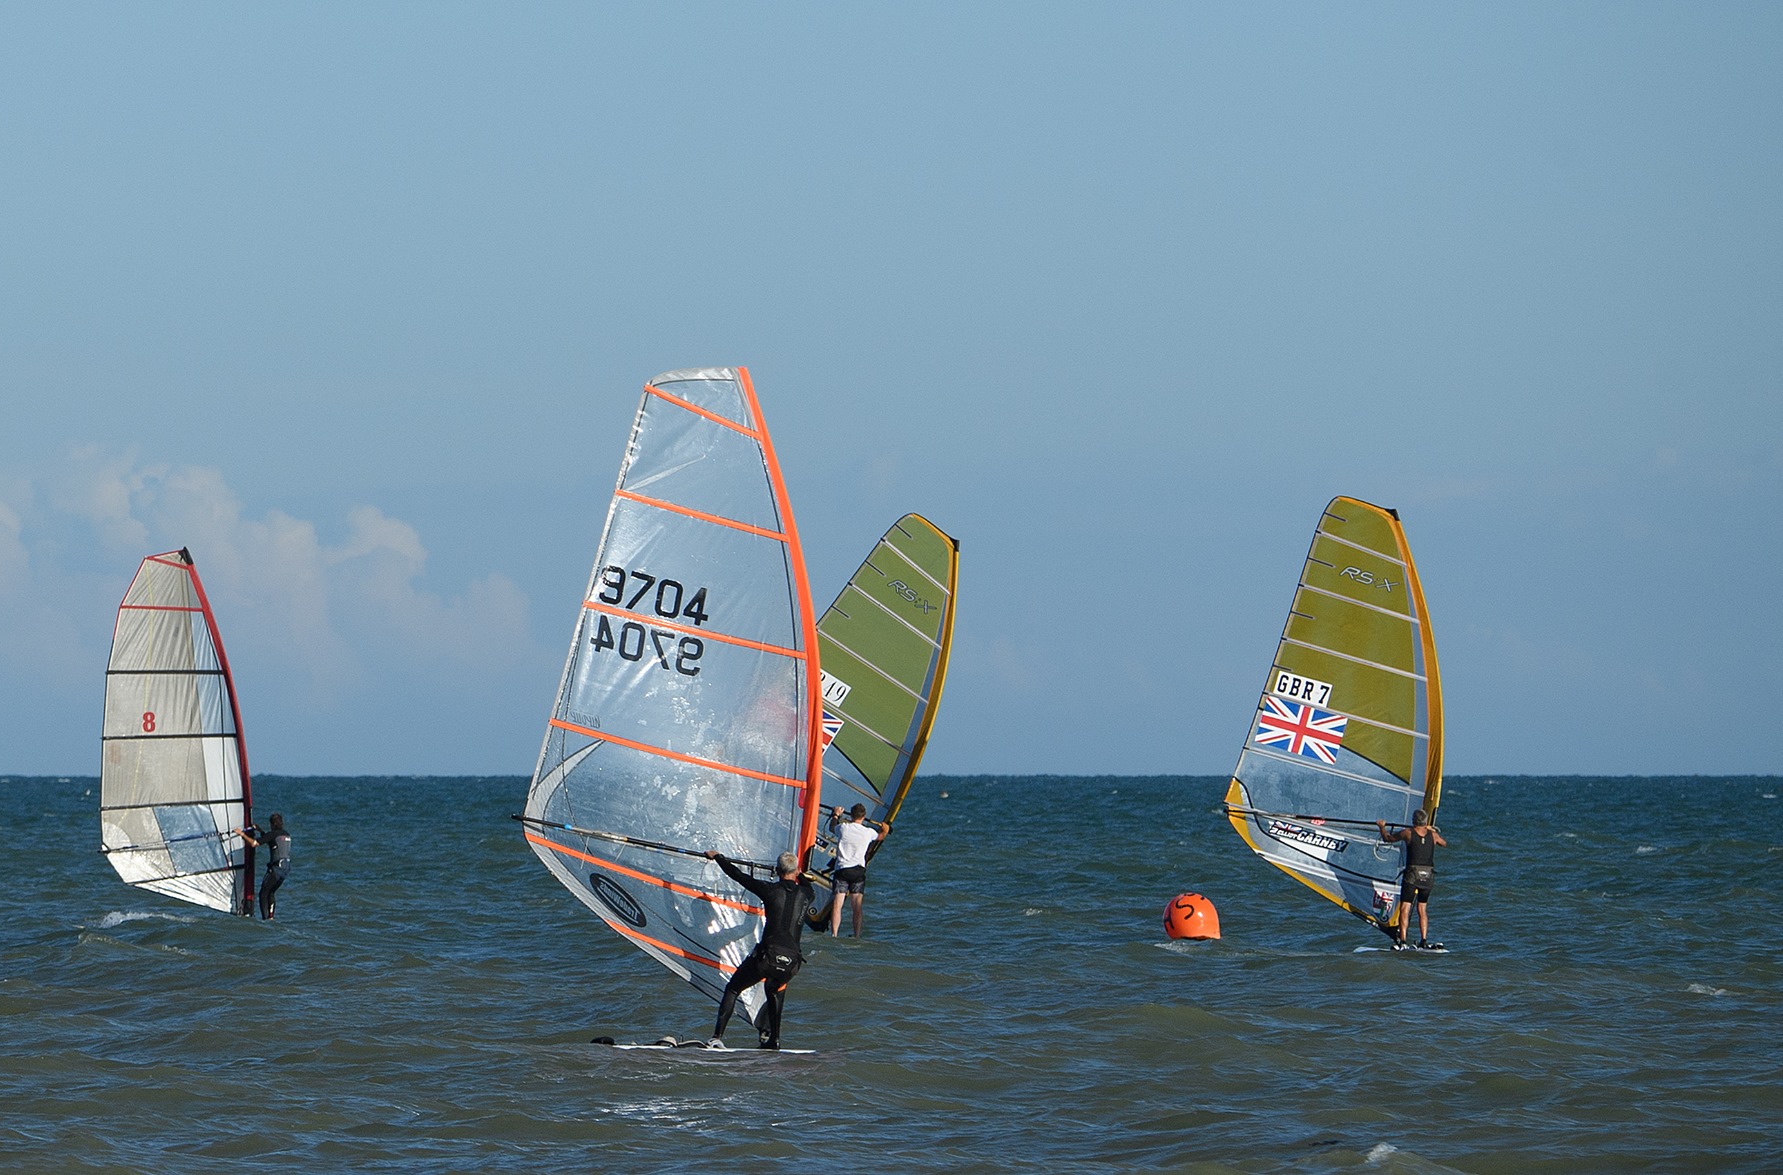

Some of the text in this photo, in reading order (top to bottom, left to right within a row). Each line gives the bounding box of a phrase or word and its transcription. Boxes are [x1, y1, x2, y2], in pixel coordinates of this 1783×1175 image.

[599, 565, 709, 626] 9704
[1277, 674, 1330, 704] GBR 7
[142, 711, 156, 733] 8
[1296, 830, 1346, 852] CARNEY
